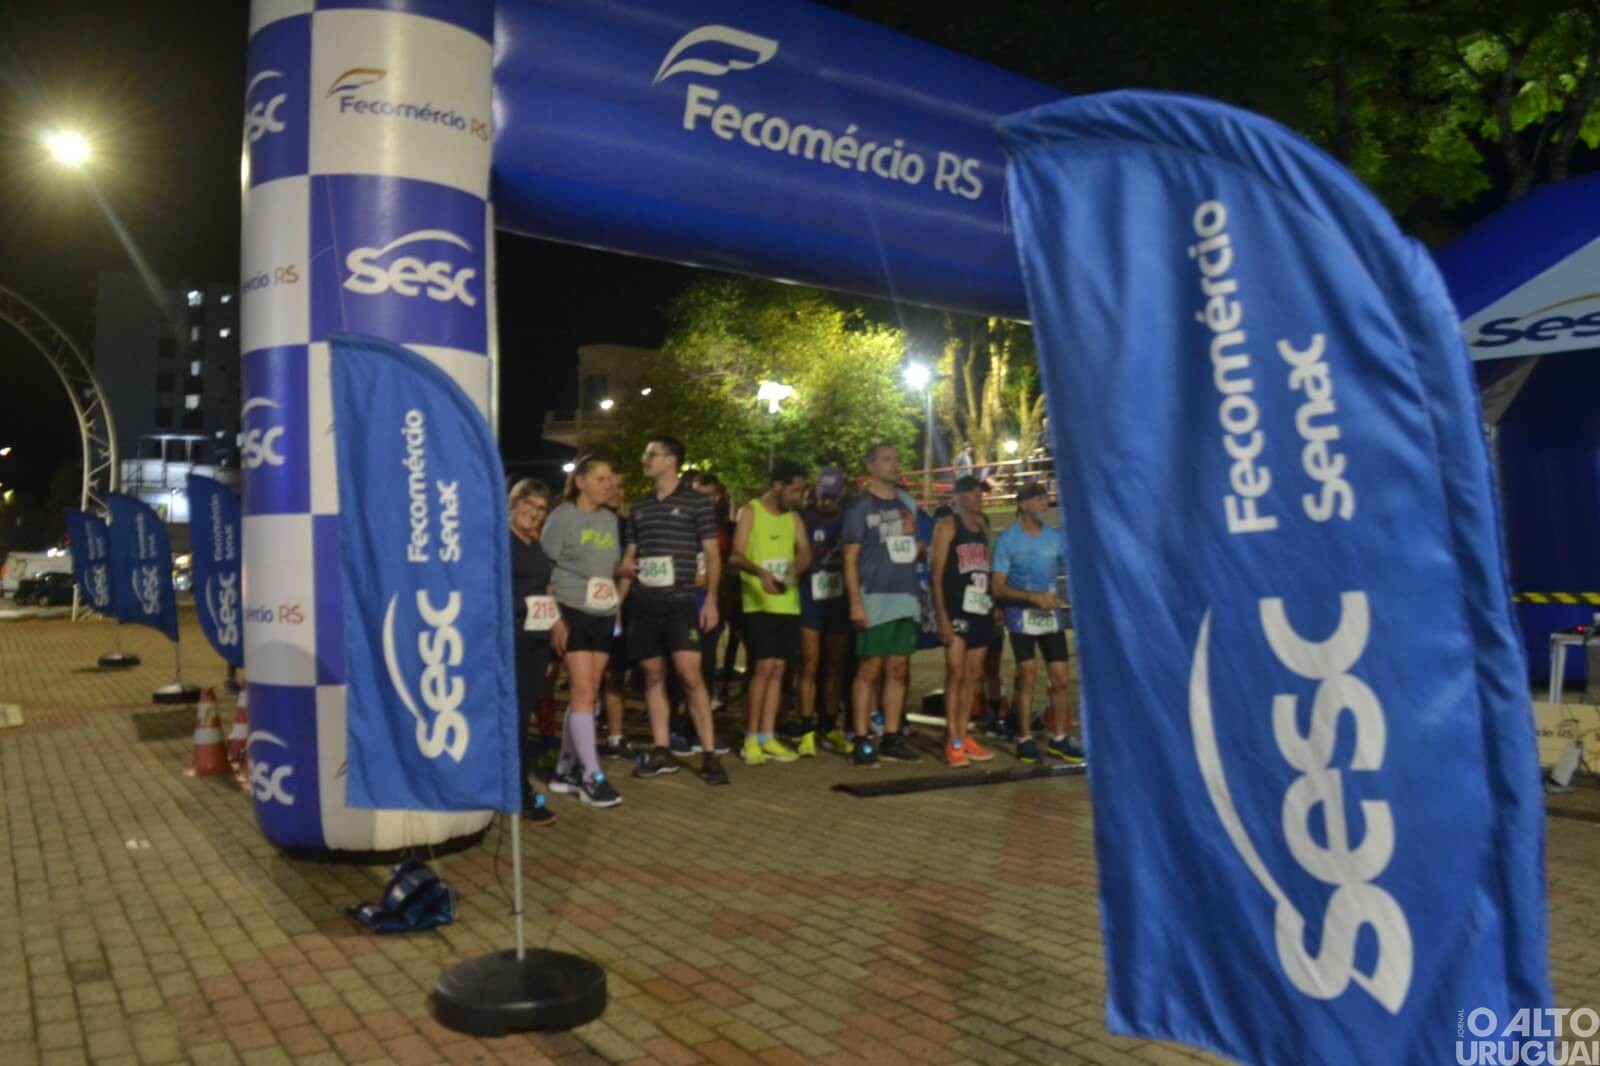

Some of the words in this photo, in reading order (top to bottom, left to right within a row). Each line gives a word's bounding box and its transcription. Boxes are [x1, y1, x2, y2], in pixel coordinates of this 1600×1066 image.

[338, 95, 467, 131] Fecomércio
[683, 84, 925, 185] Fecomércio
[934, 151, 984, 200] RS
[273, 264, 300, 287] RS
[343, 246, 477, 307] Sesc
[1188, 200, 1280, 534] Fecomércio
[401, 409, 431, 563] Fecomércio
[277, 604, 305, 626] RS
[416, 589, 471, 764] Sesc
[1259, 590, 1414, 1016] Sesc
